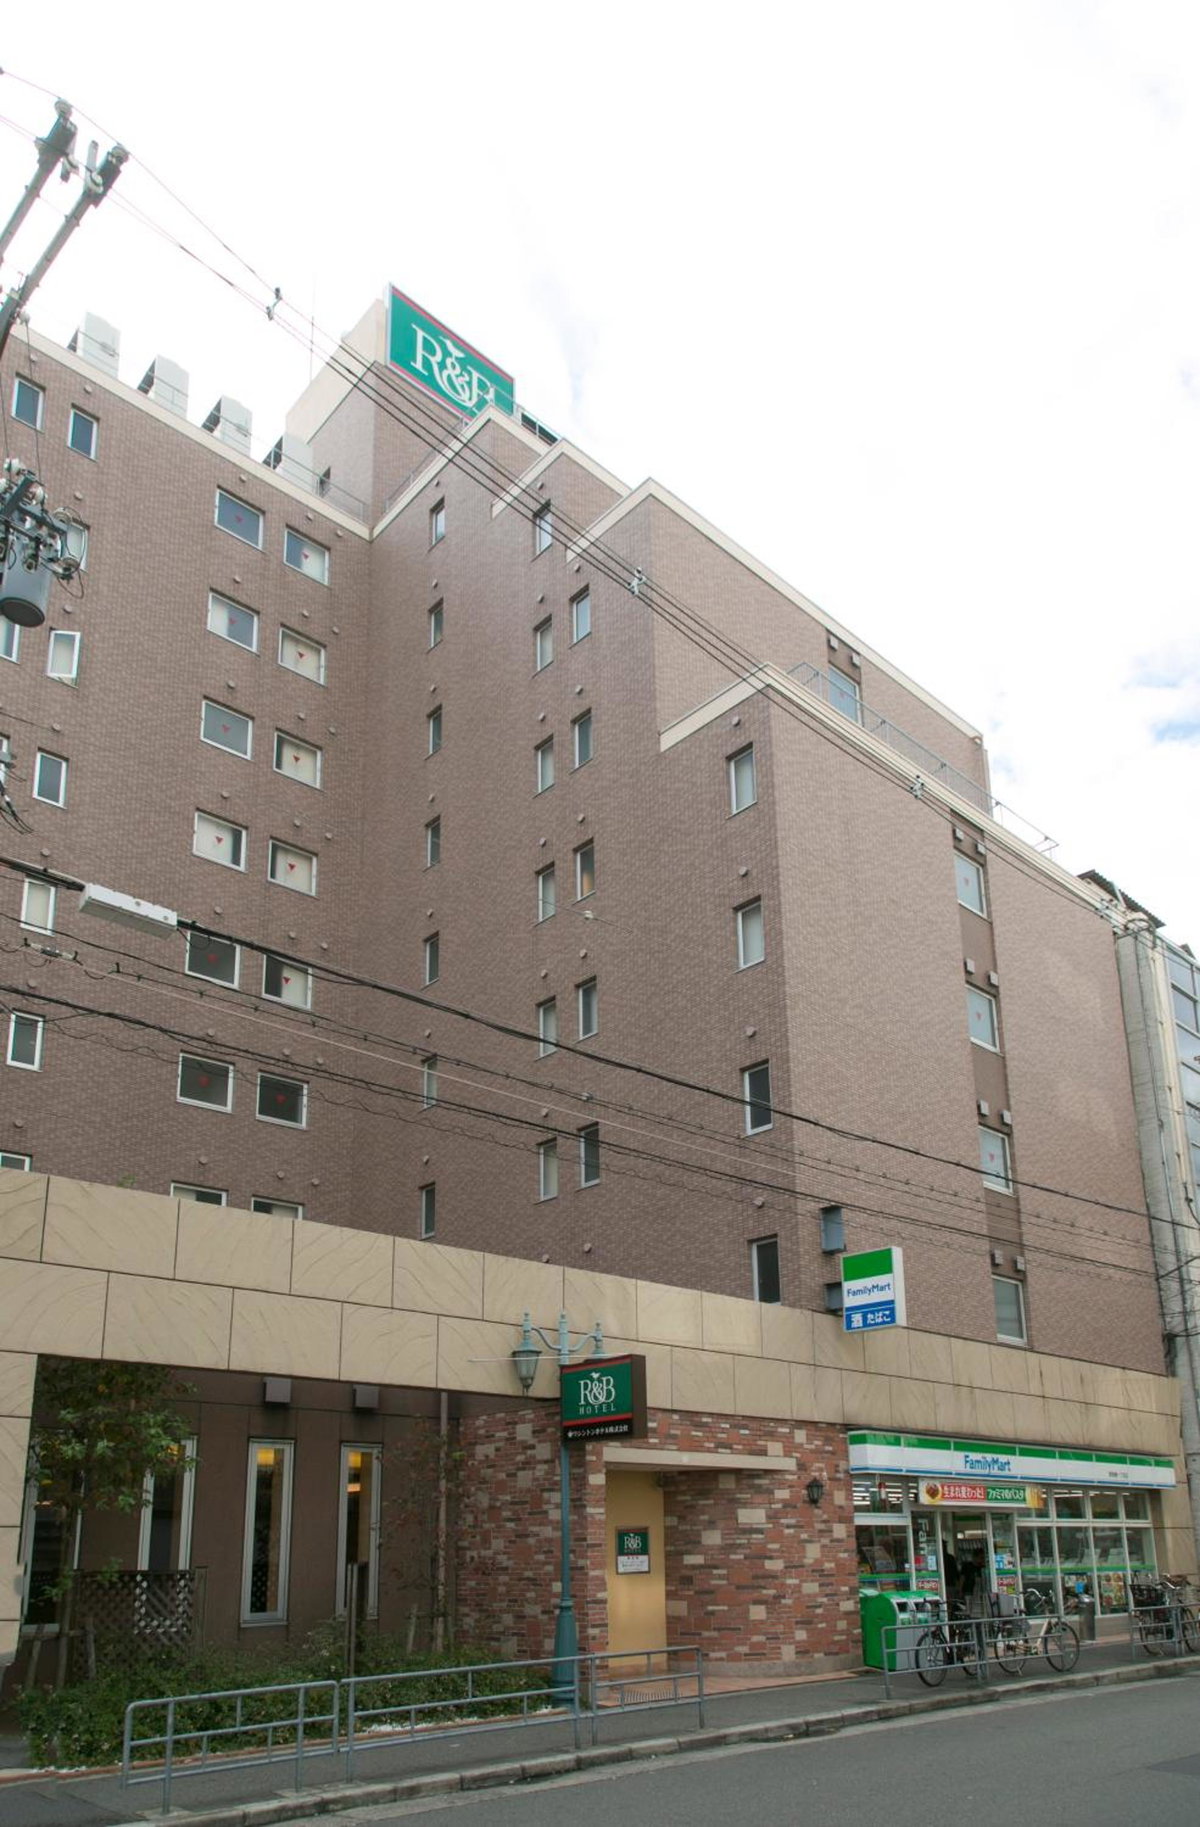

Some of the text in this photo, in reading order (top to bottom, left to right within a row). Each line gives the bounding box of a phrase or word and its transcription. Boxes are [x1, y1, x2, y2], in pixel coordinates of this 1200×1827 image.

[847, 1283, 892, 1297] FamilyMart
[867, 1311, 891, 1325] たばこ
[578, 1375, 616, 1405] R&B
[579, 1403, 616, 1415] HOTEL
[964, 1454, 1011, 1473] FamilyMart
